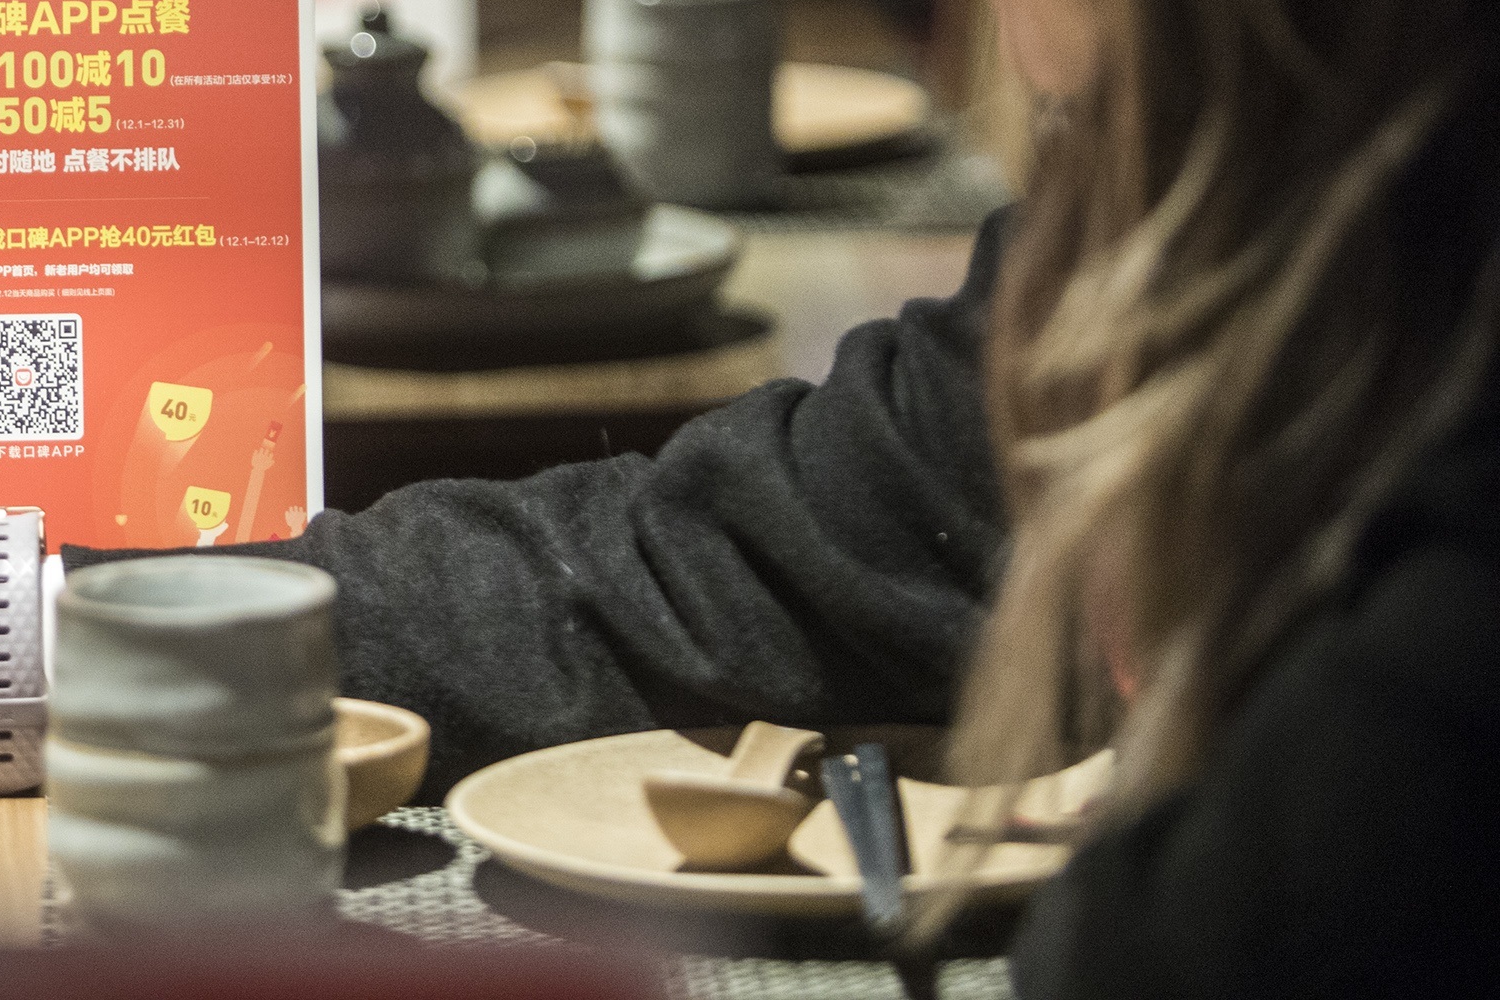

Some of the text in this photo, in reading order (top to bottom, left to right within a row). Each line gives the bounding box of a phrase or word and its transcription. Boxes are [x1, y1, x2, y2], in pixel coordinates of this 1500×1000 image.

[63, 148, 180, 173] 点餐不排队
